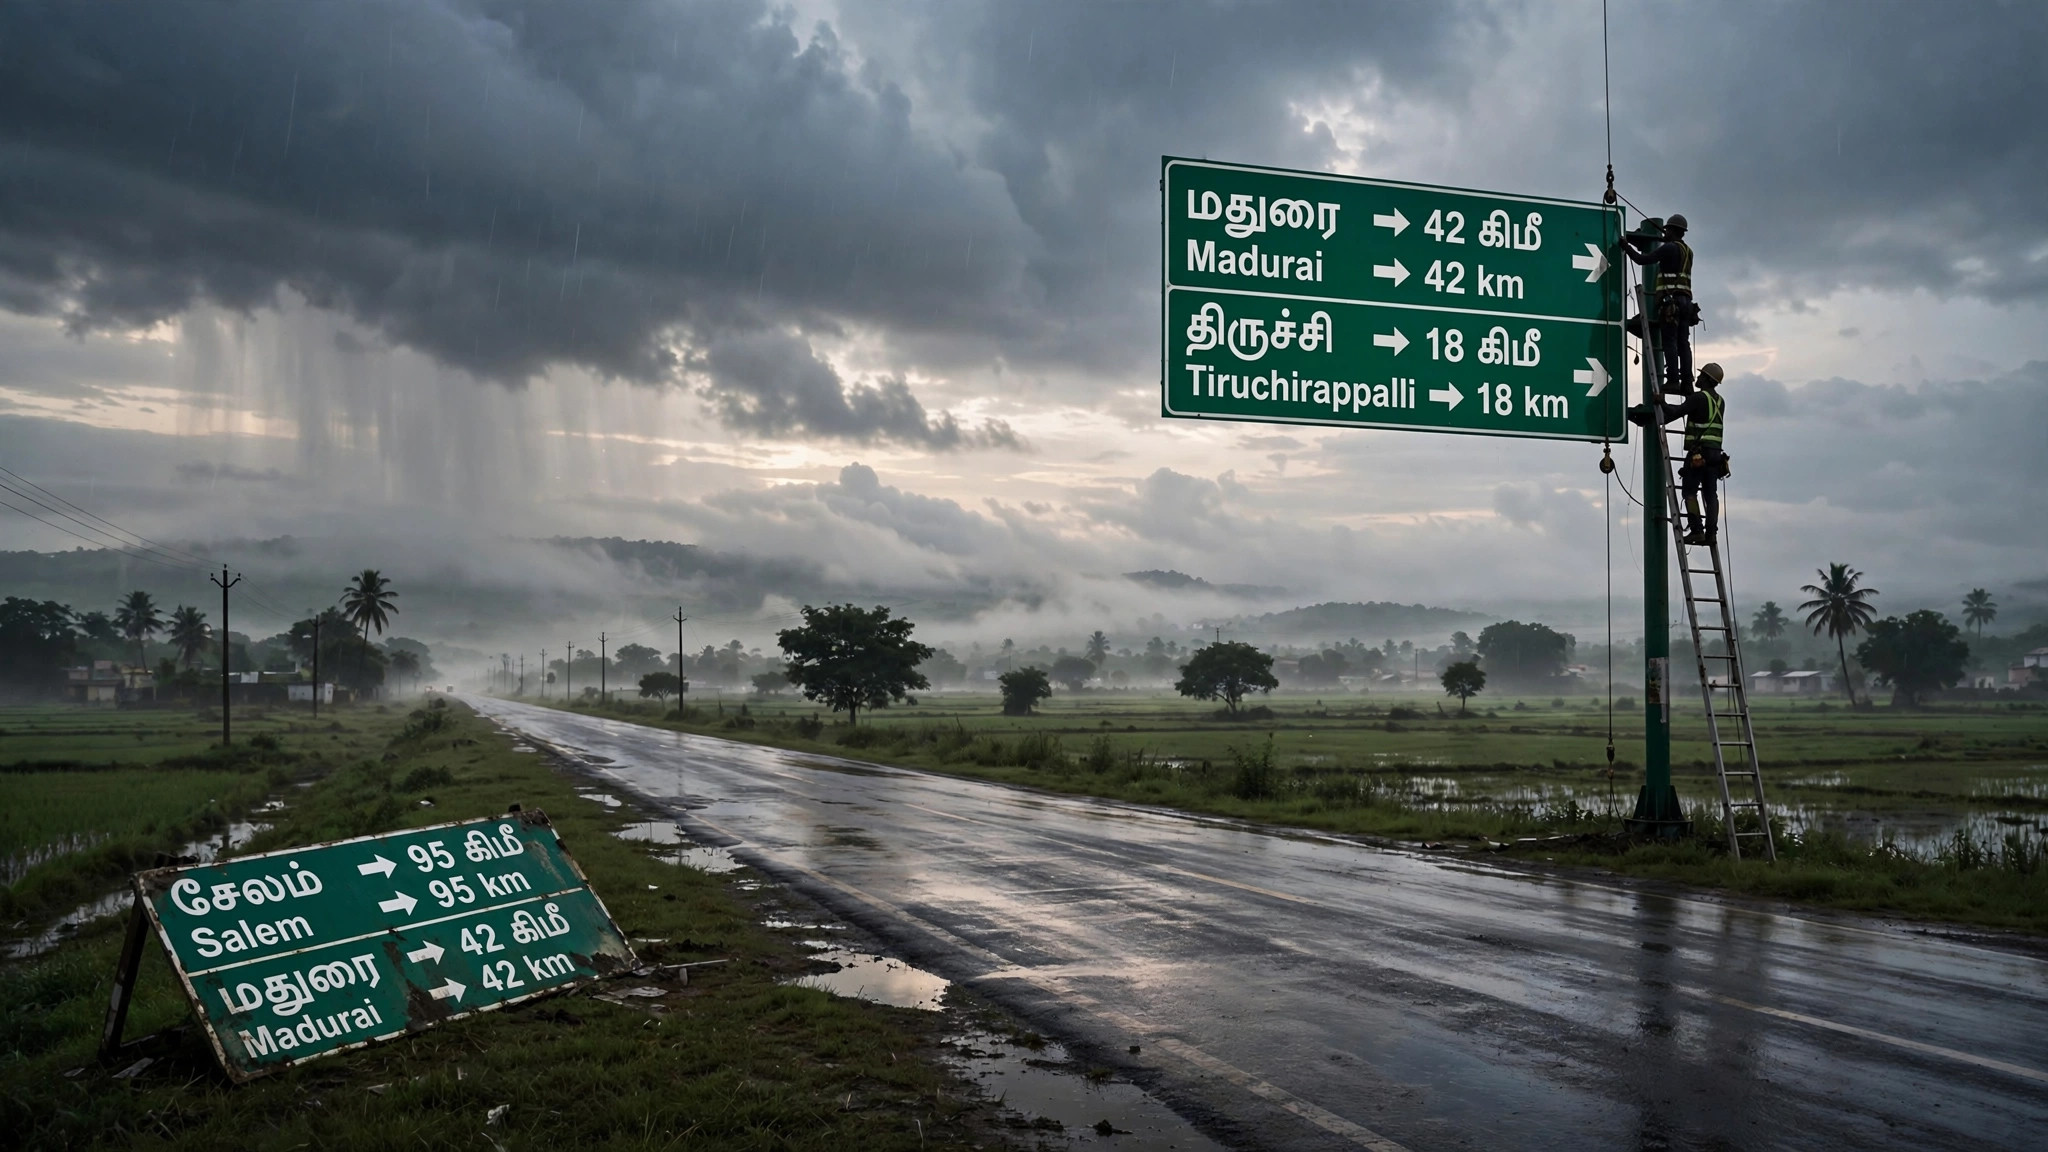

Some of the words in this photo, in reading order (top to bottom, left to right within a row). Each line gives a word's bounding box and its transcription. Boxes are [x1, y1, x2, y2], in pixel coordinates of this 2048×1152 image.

[1187, 189, 1341, 241] மதுரை
[1423, 209, 1465, 245] 42
[1478, 209, 1543, 251] கிமீ
[1187, 238, 1323, 282] Madurai
[1424, 259, 1465, 295] 42
[1477, 264, 1524, 300] km
[1185, 301, 1333, 362] திருச்சி
[1426, 327, 1465, 363] 18
[1477, 325, 1542, 367] கிமீ
[1185, 363, 1415, 414] Tiruchirappalli
[1477, 382, 1513, 416] 18
[1524, 385, 1569, 419] km
[170, 860, 323, 916] சேலம்
[407, 840, 456, 873] 95
[463, 823, 525, 863] கிமீ
[191, 916, 315, 958] Salem
[428, 875, 476, 908] 95
[476, 871, 532, 898] km
[217, 952, 381, 1017] மதுரை
[461, 923, 506, 956] 42
[510, 902, 571, 944] கிமீ
[238, 997, 383, 1059] Madurai
[482, 959, 525, 992] 42
[522, 953, 576, 981] km
